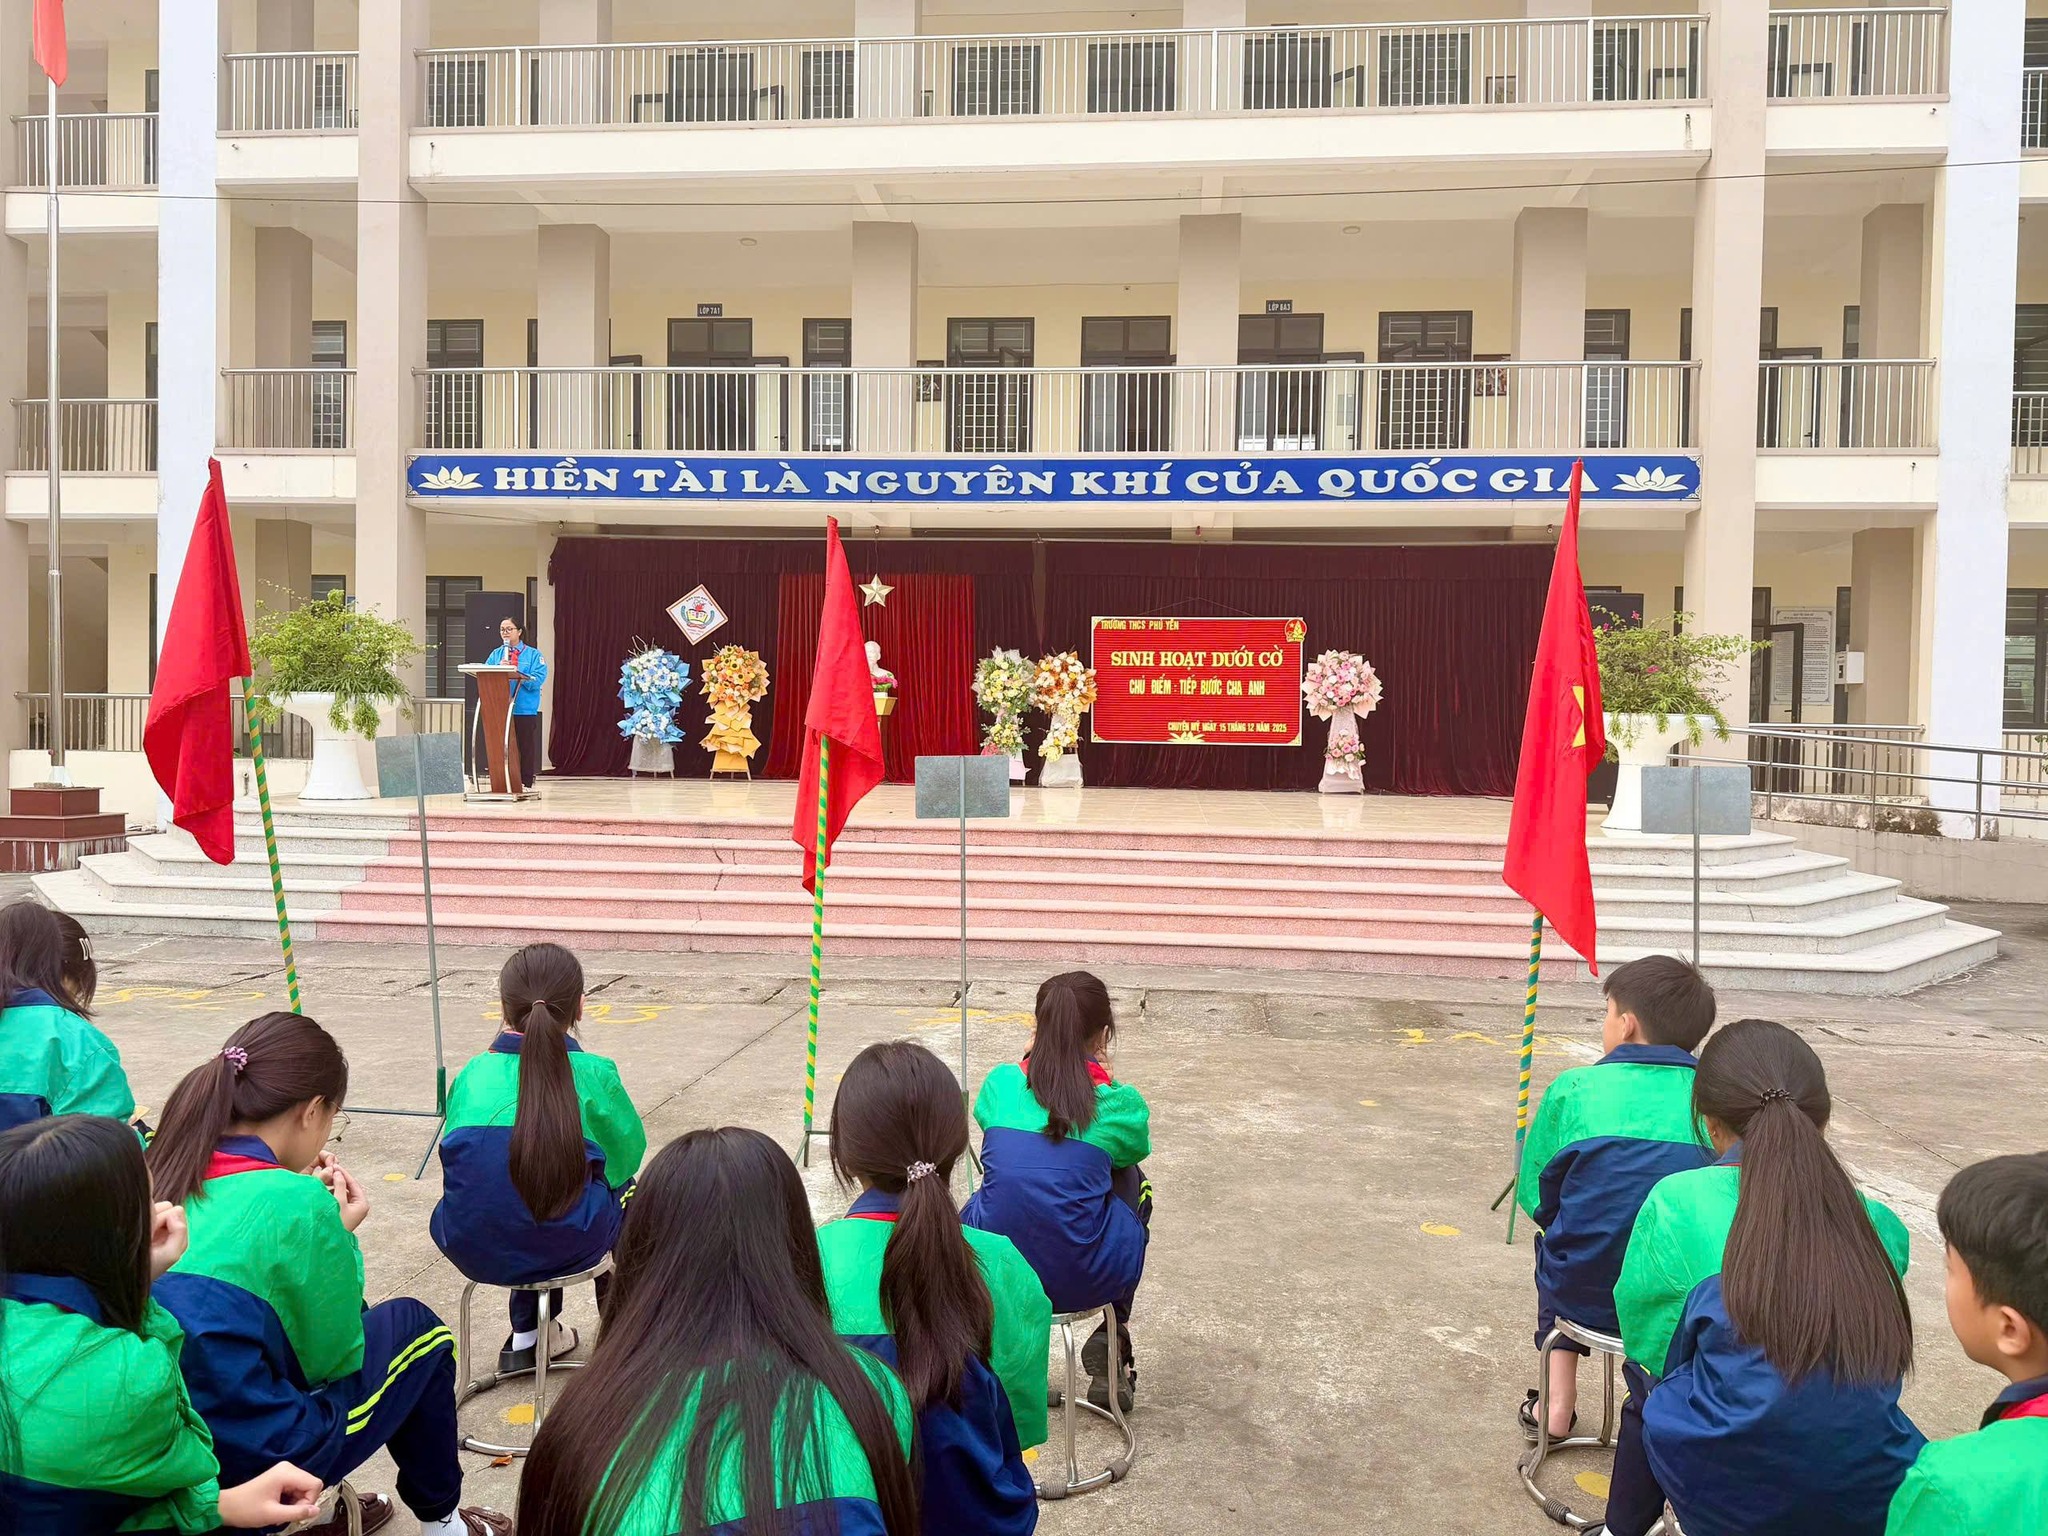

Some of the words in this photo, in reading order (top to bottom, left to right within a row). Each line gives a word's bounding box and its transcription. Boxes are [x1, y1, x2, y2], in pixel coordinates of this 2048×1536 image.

[493, 456, 620, 491] HIỀN
[632, 460, 728, 492] TÀI
[739, 461, 811, 494] LÀ
[823, 465, 1057, 495] NGUYÊN
[1069, 461, 1173, 495] KHÍ
[1184, 460, 1304, 495] CỦA
[1317, 457, 1478, 498] QUỐC
[1129, 620, 1146, 630] THCS
[1110, 650, 1155, 667] SINH
[1159, 651, 1206, 671] HOẠT
[1211, 645, 1255, 668] DƯỚI
[1258, 644, 1283, 668] CỜ
[1129, 675, 1146, 695] CHỦ
[1179, 674, 1197, 695] TIẾP
[1226, 680, 1243, 696] CHA
[1248, 680, 1266, 696] ANH
[1219, 722, 1227, 732] 15
